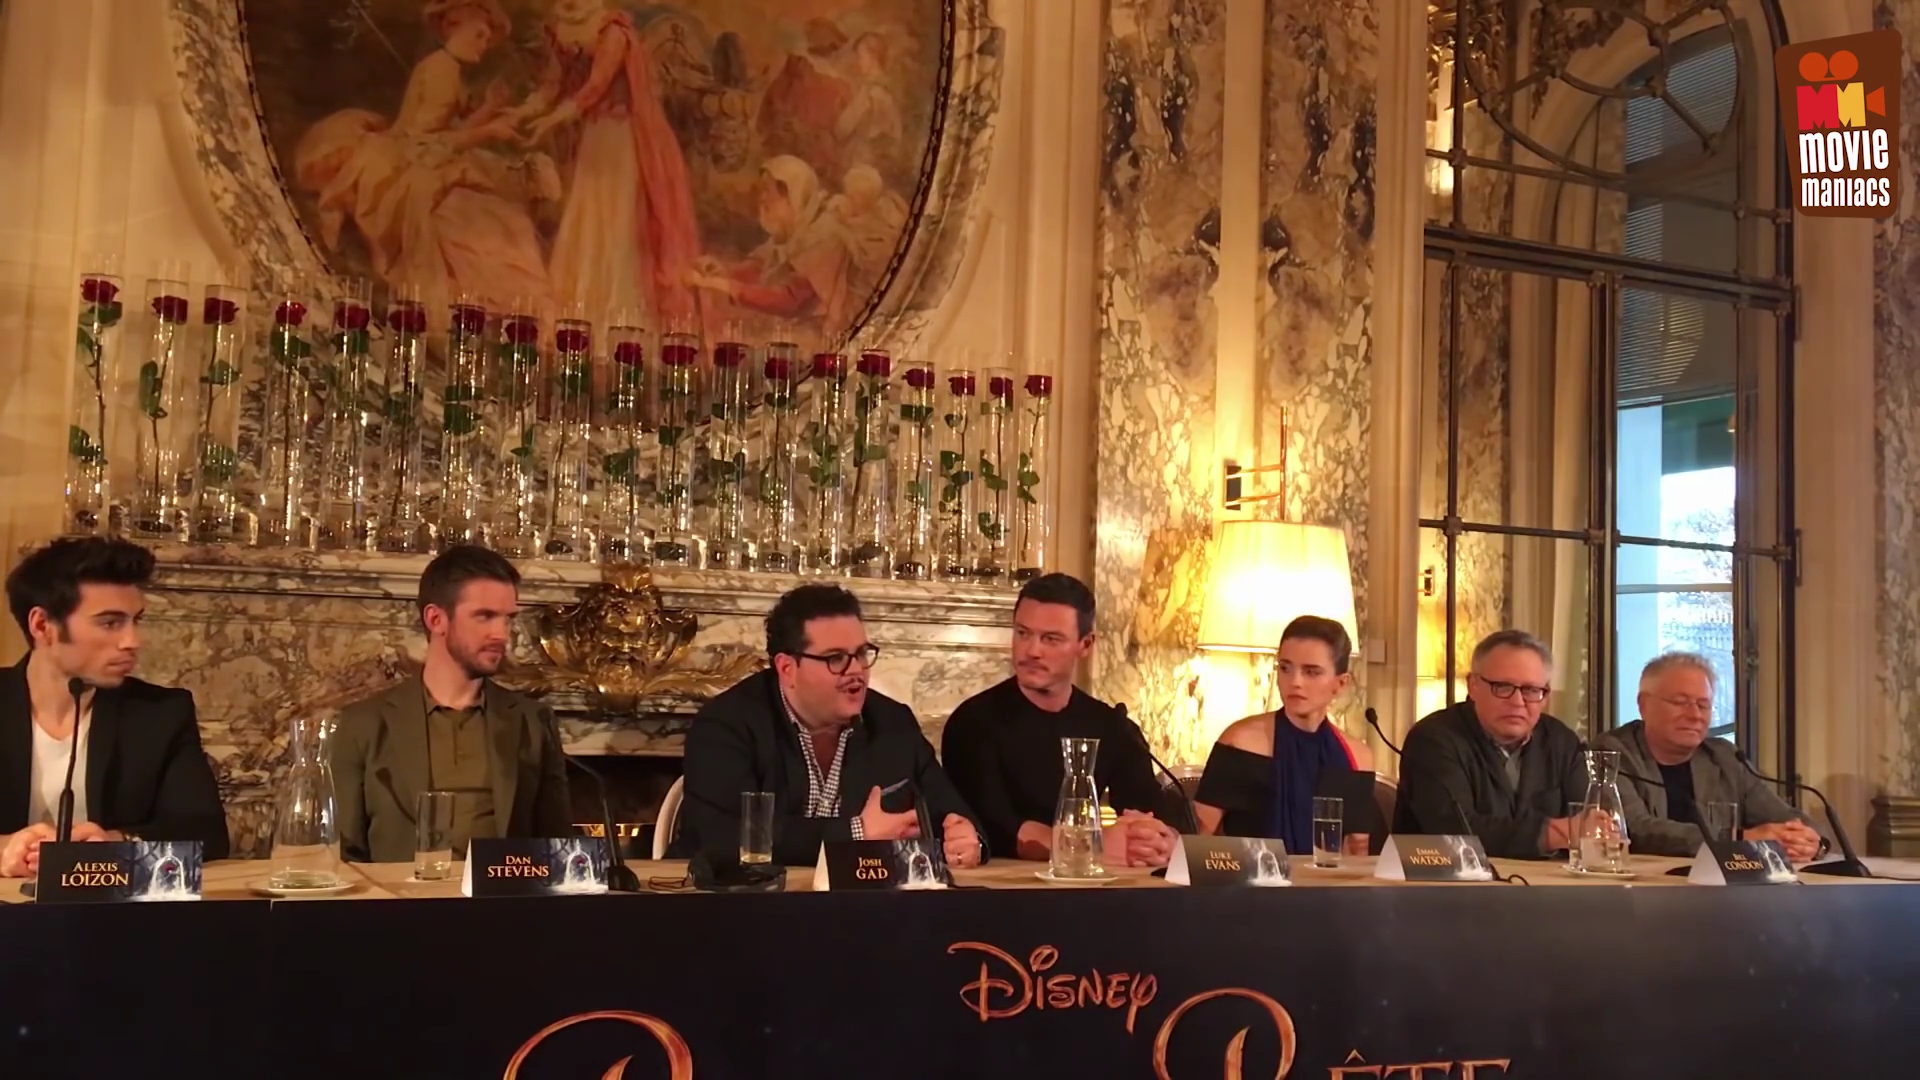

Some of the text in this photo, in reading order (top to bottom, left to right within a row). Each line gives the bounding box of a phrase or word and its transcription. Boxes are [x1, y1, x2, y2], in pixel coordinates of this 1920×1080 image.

[505, 855, 532, 865] DAN
[1209, 850, 1233, 860] LUKE
[1409, 855, 1453, 866] WATSON
[72, 861, 119, 873] ALEXIS
[858, 857, 883, 868] JOSH
[1204, 859, 1241, 872] EVANS
[1724, 860, 1765, 871] CONDON
[487, 865, 550, 878] STEVENS
[856, 868, 889, 880] GAD
[61, 872, 130, 887] LOIZON
